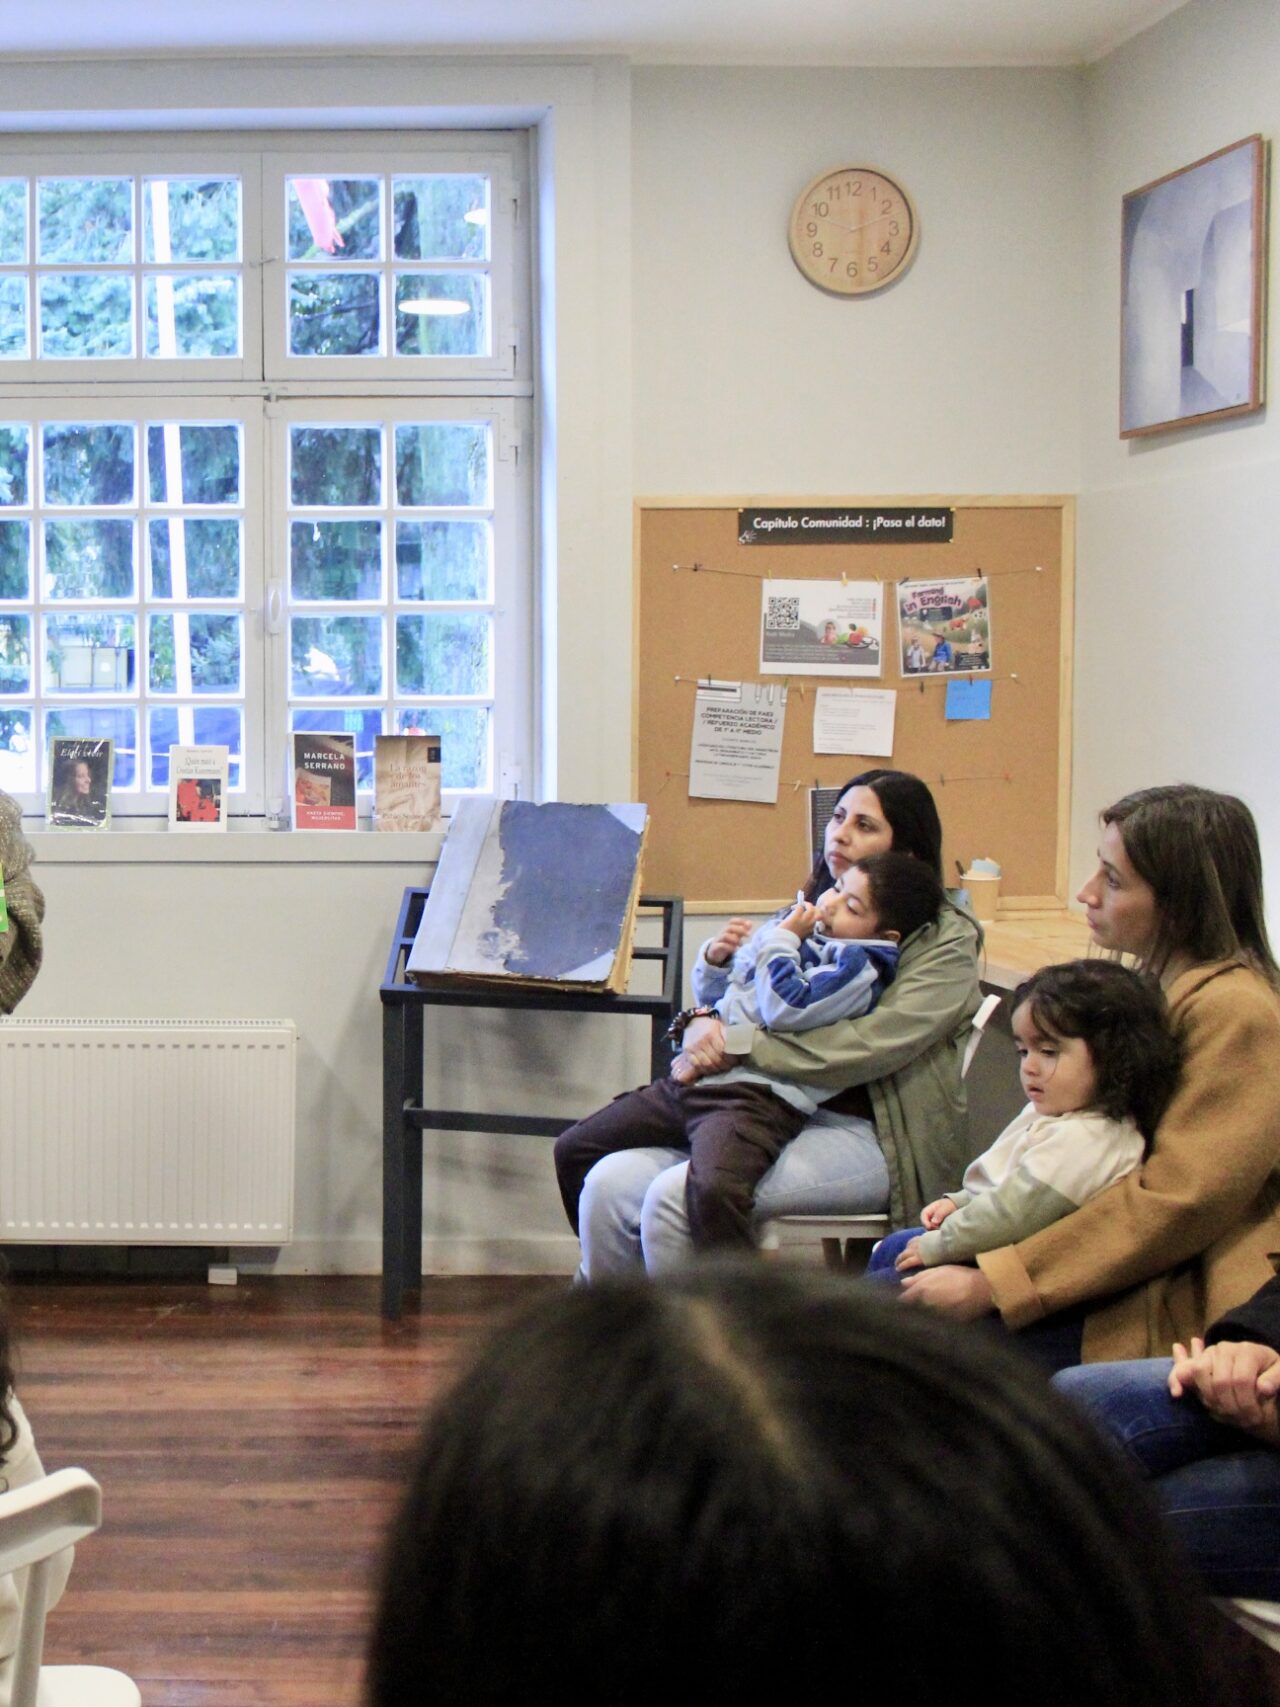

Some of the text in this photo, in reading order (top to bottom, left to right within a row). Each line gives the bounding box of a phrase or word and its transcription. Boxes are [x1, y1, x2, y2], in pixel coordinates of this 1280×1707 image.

[827, 186, 841, 200] 11
[845, 181, 863, 196] 12
[871, 187, 877, 201] 1
[812, 202, 829, 217] 10
[881, 200, 893, 214] 2
[806, 222, 818, 237] 9
[888, 221, 900, 236] 3
[812, 242, 824, 257] 8
[880, 240, 891, 255] 4
[828, 258, 839, 273] 7
[846, 262, 858, 278] 6
[868, 256, 878, 272] 5
[753, 516, 799, 532] Capítulo
[801, 516, 863, 529] Comunidad
[872, 516, 902, 531] ¡Pasa
[905, 515, 915, 528] el
[917, 515, 946, 528] dato!
[905, 595, 962, 612] in English
[304, 753, 345, 761] MARCELA
